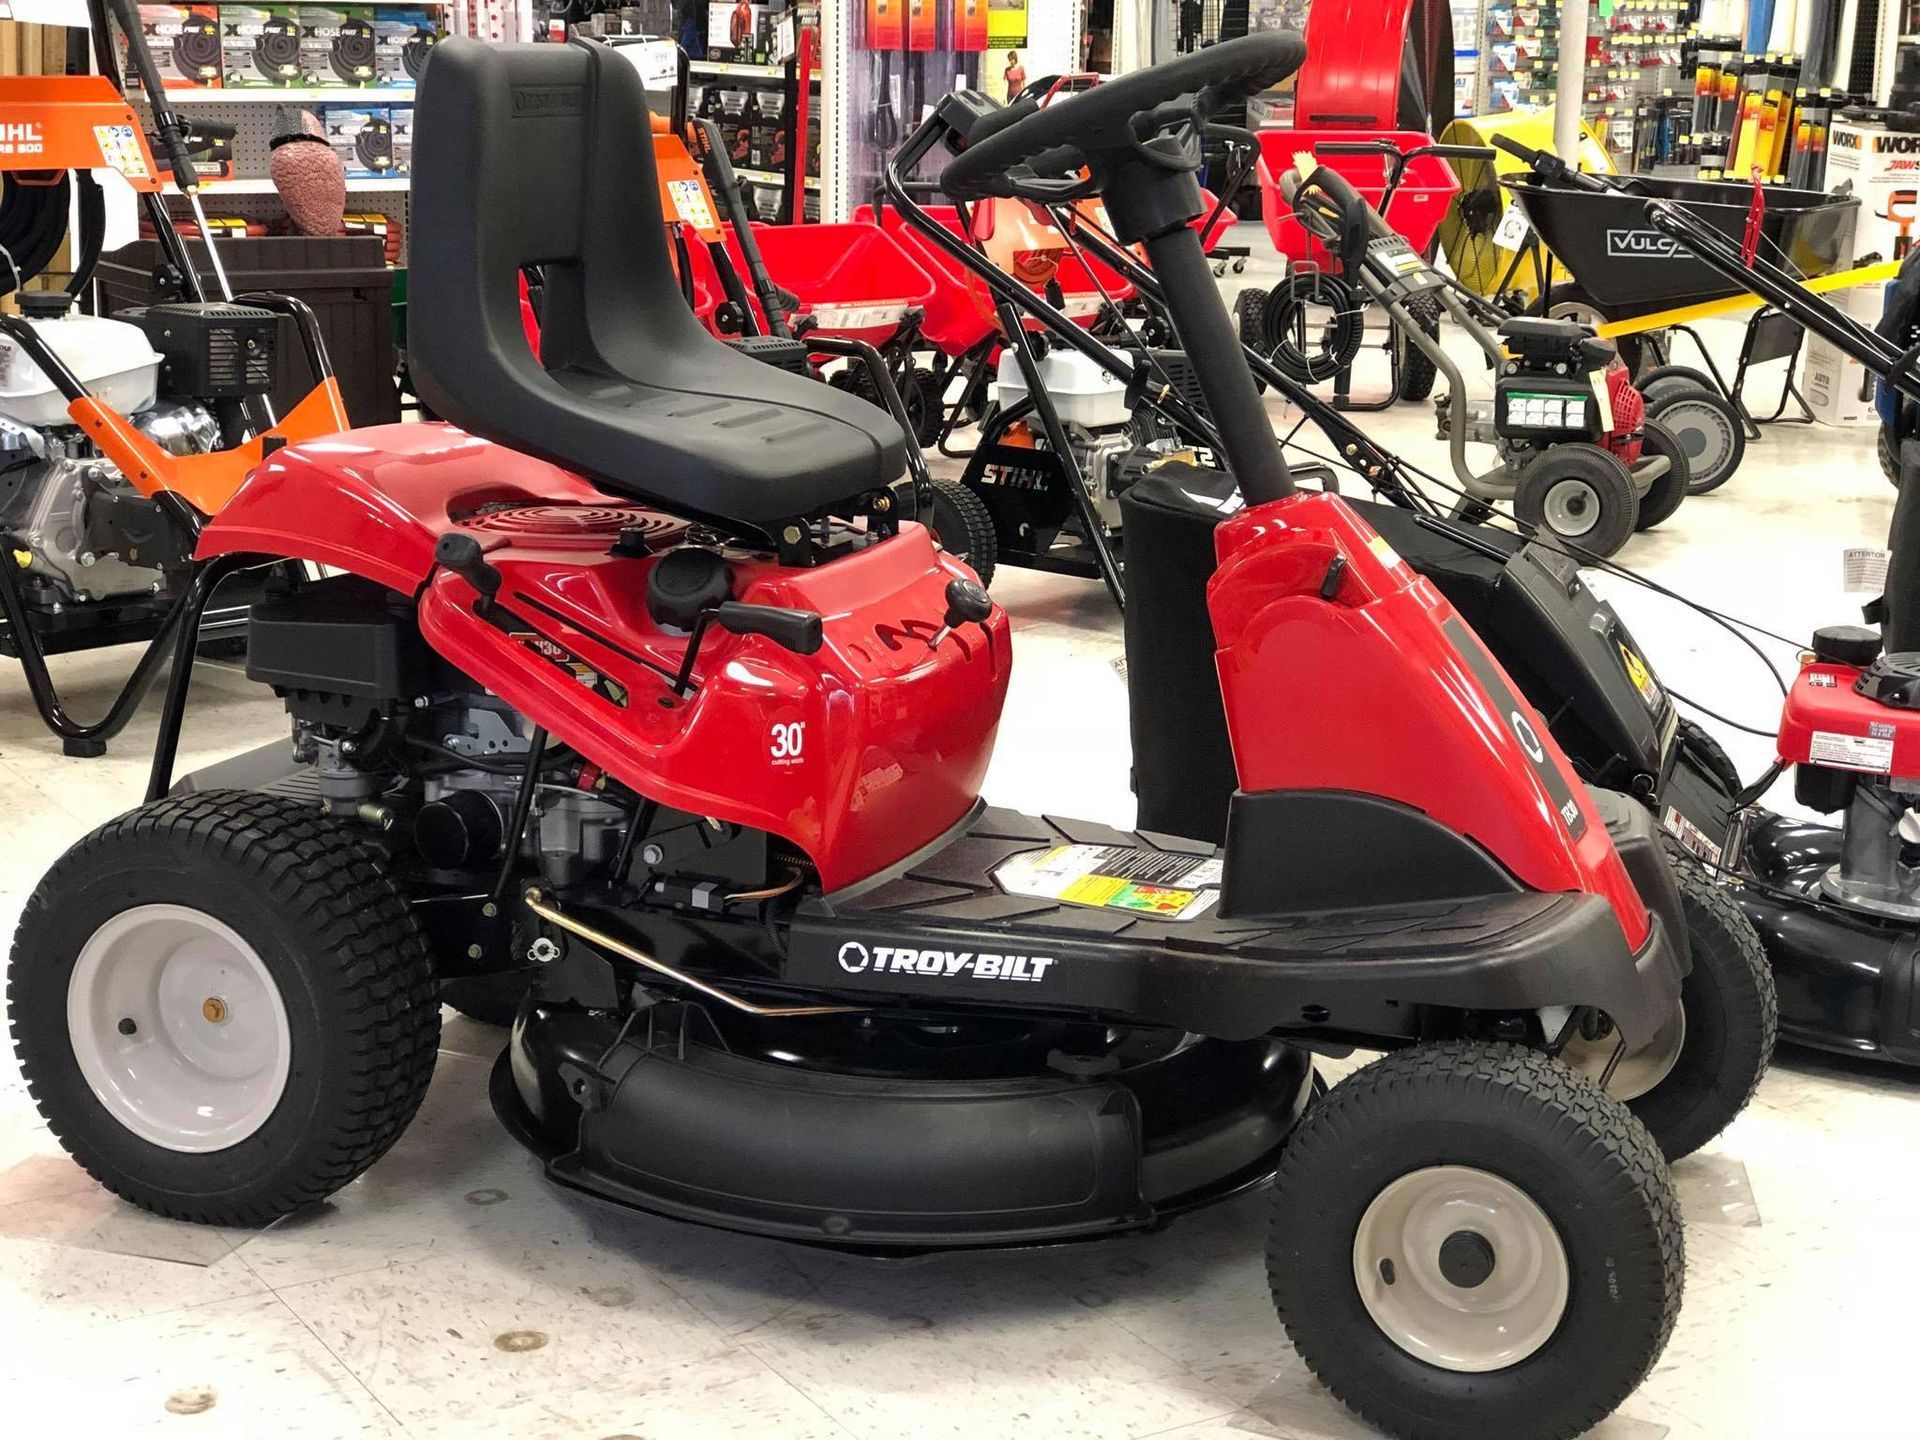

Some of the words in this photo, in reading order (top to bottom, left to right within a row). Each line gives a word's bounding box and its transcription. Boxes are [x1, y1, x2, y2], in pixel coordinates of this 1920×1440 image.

[1833, 130, 1859, 149] WORX
[981, 463, 1049, 491] STIHL
[1561, 799, 1579, 827] TB30
[872, 946, 1054, 982] TROY-BILT
